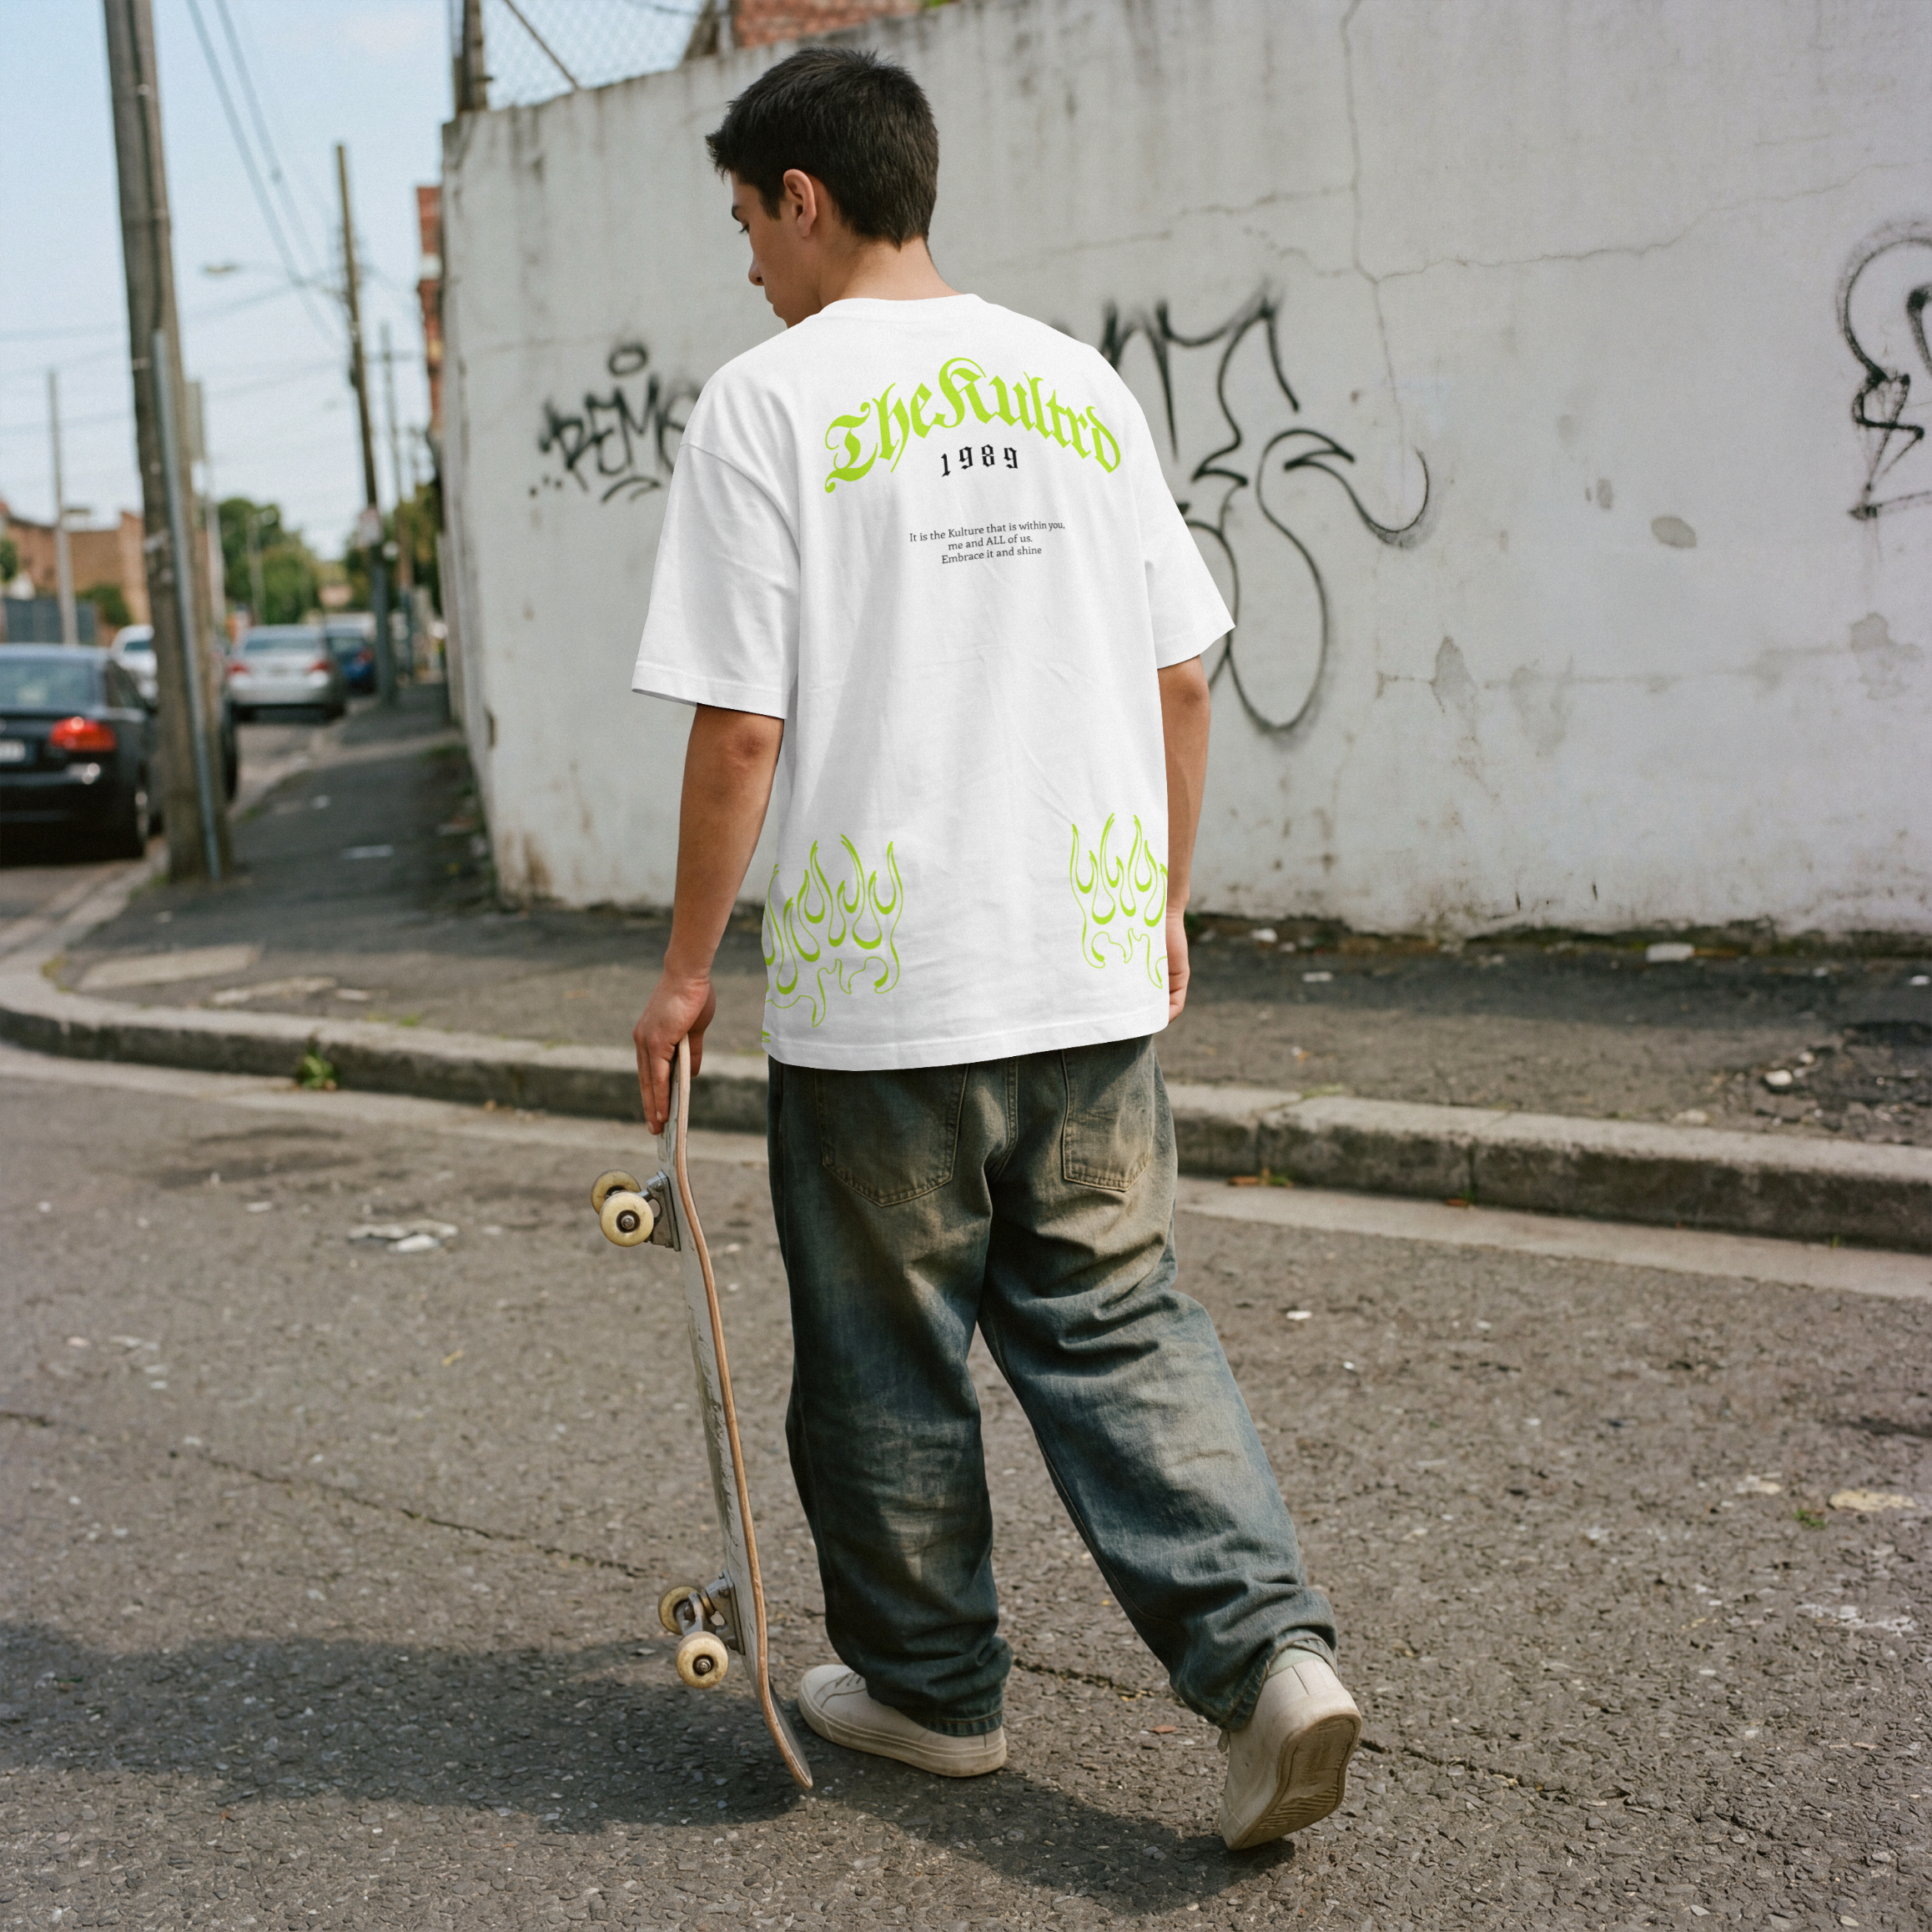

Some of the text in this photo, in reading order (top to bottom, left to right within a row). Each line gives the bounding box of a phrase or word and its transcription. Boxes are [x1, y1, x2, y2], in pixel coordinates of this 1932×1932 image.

[941, 444, 1019, 477] 1989
[909, 520, 1065, 542] It is the Kulture that is within you,
[948, 542, 963, 551] me
[965, 536, 984, 549] and
[986, 535, 1006, 546] ALL
[1008, 533, 1019, 544] of
[941, 546, 1042, 565] Embrace it and shine
